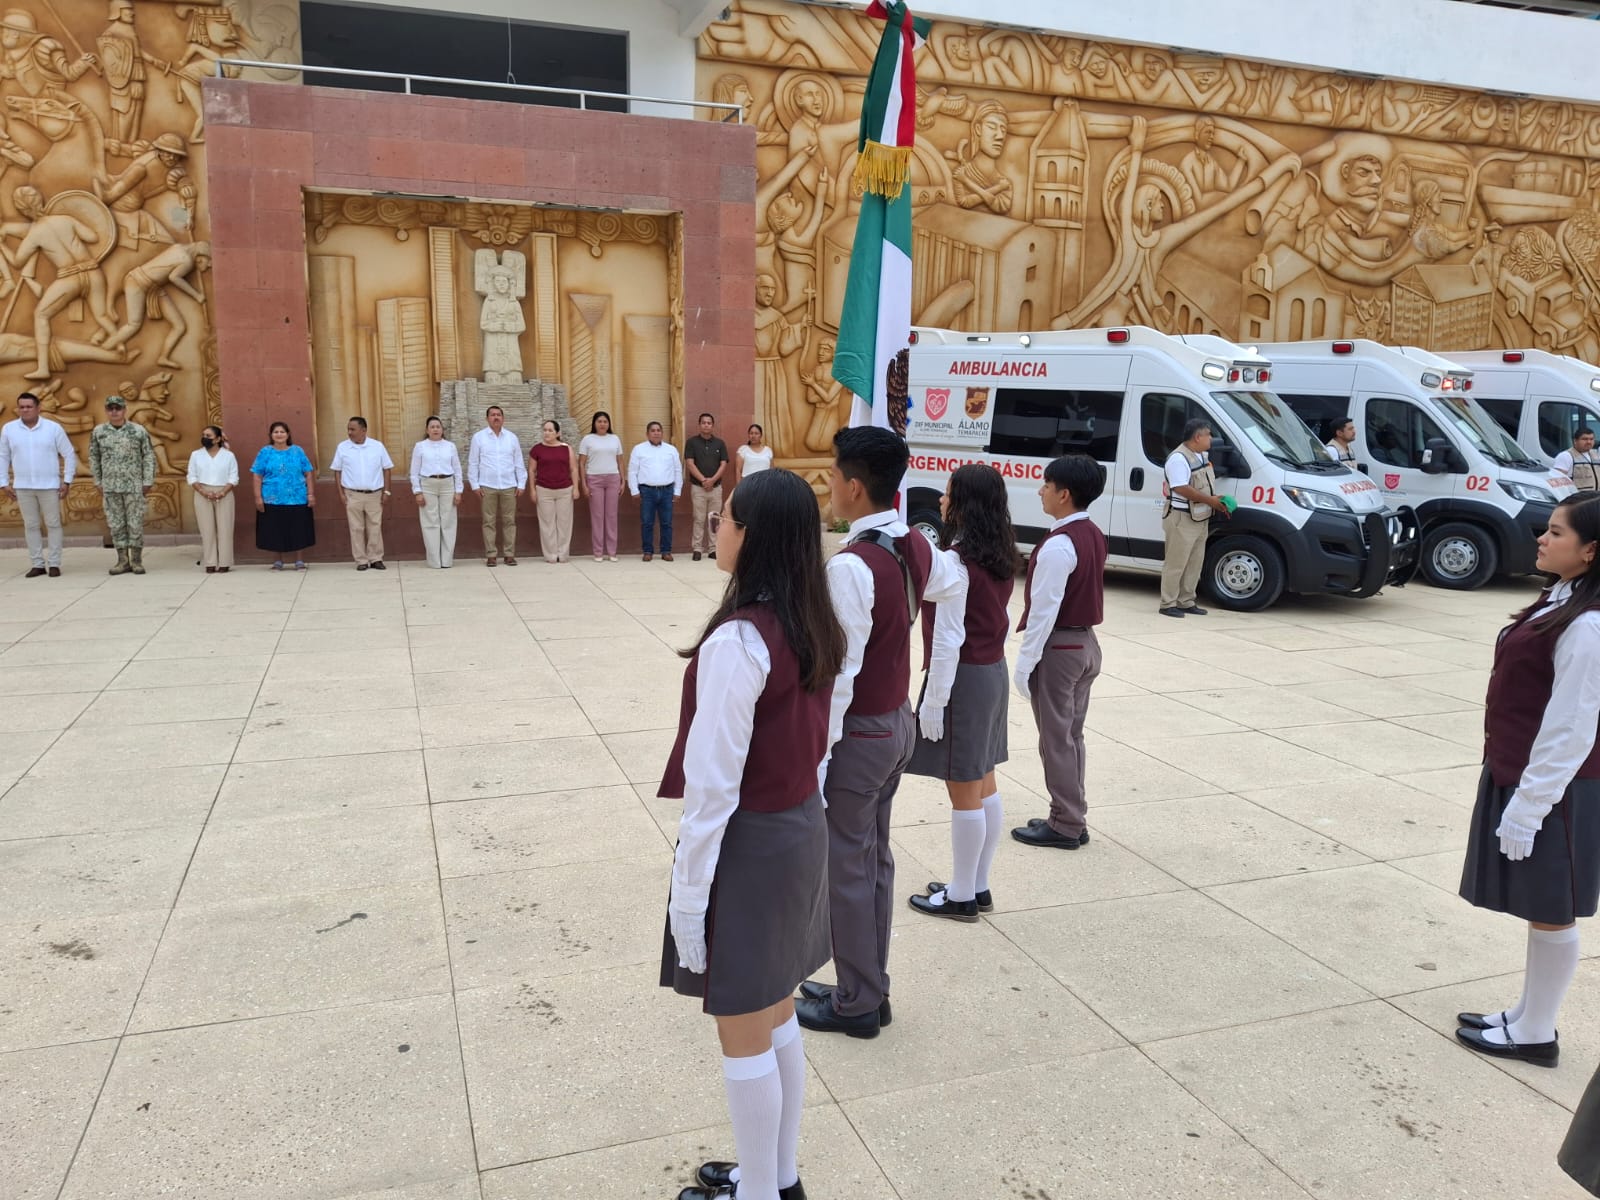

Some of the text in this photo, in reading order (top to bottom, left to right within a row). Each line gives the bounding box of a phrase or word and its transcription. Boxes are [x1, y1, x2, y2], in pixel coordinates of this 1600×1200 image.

[949, 361, 1048, 377] AMBULANCIA
[958, 418, 990, 431] ÁLAMO
[991, 459, 1044, 480] BÁSIC
[1466, 475, 1490, 491] 02
[1252, 485, 1276, 505] 01
